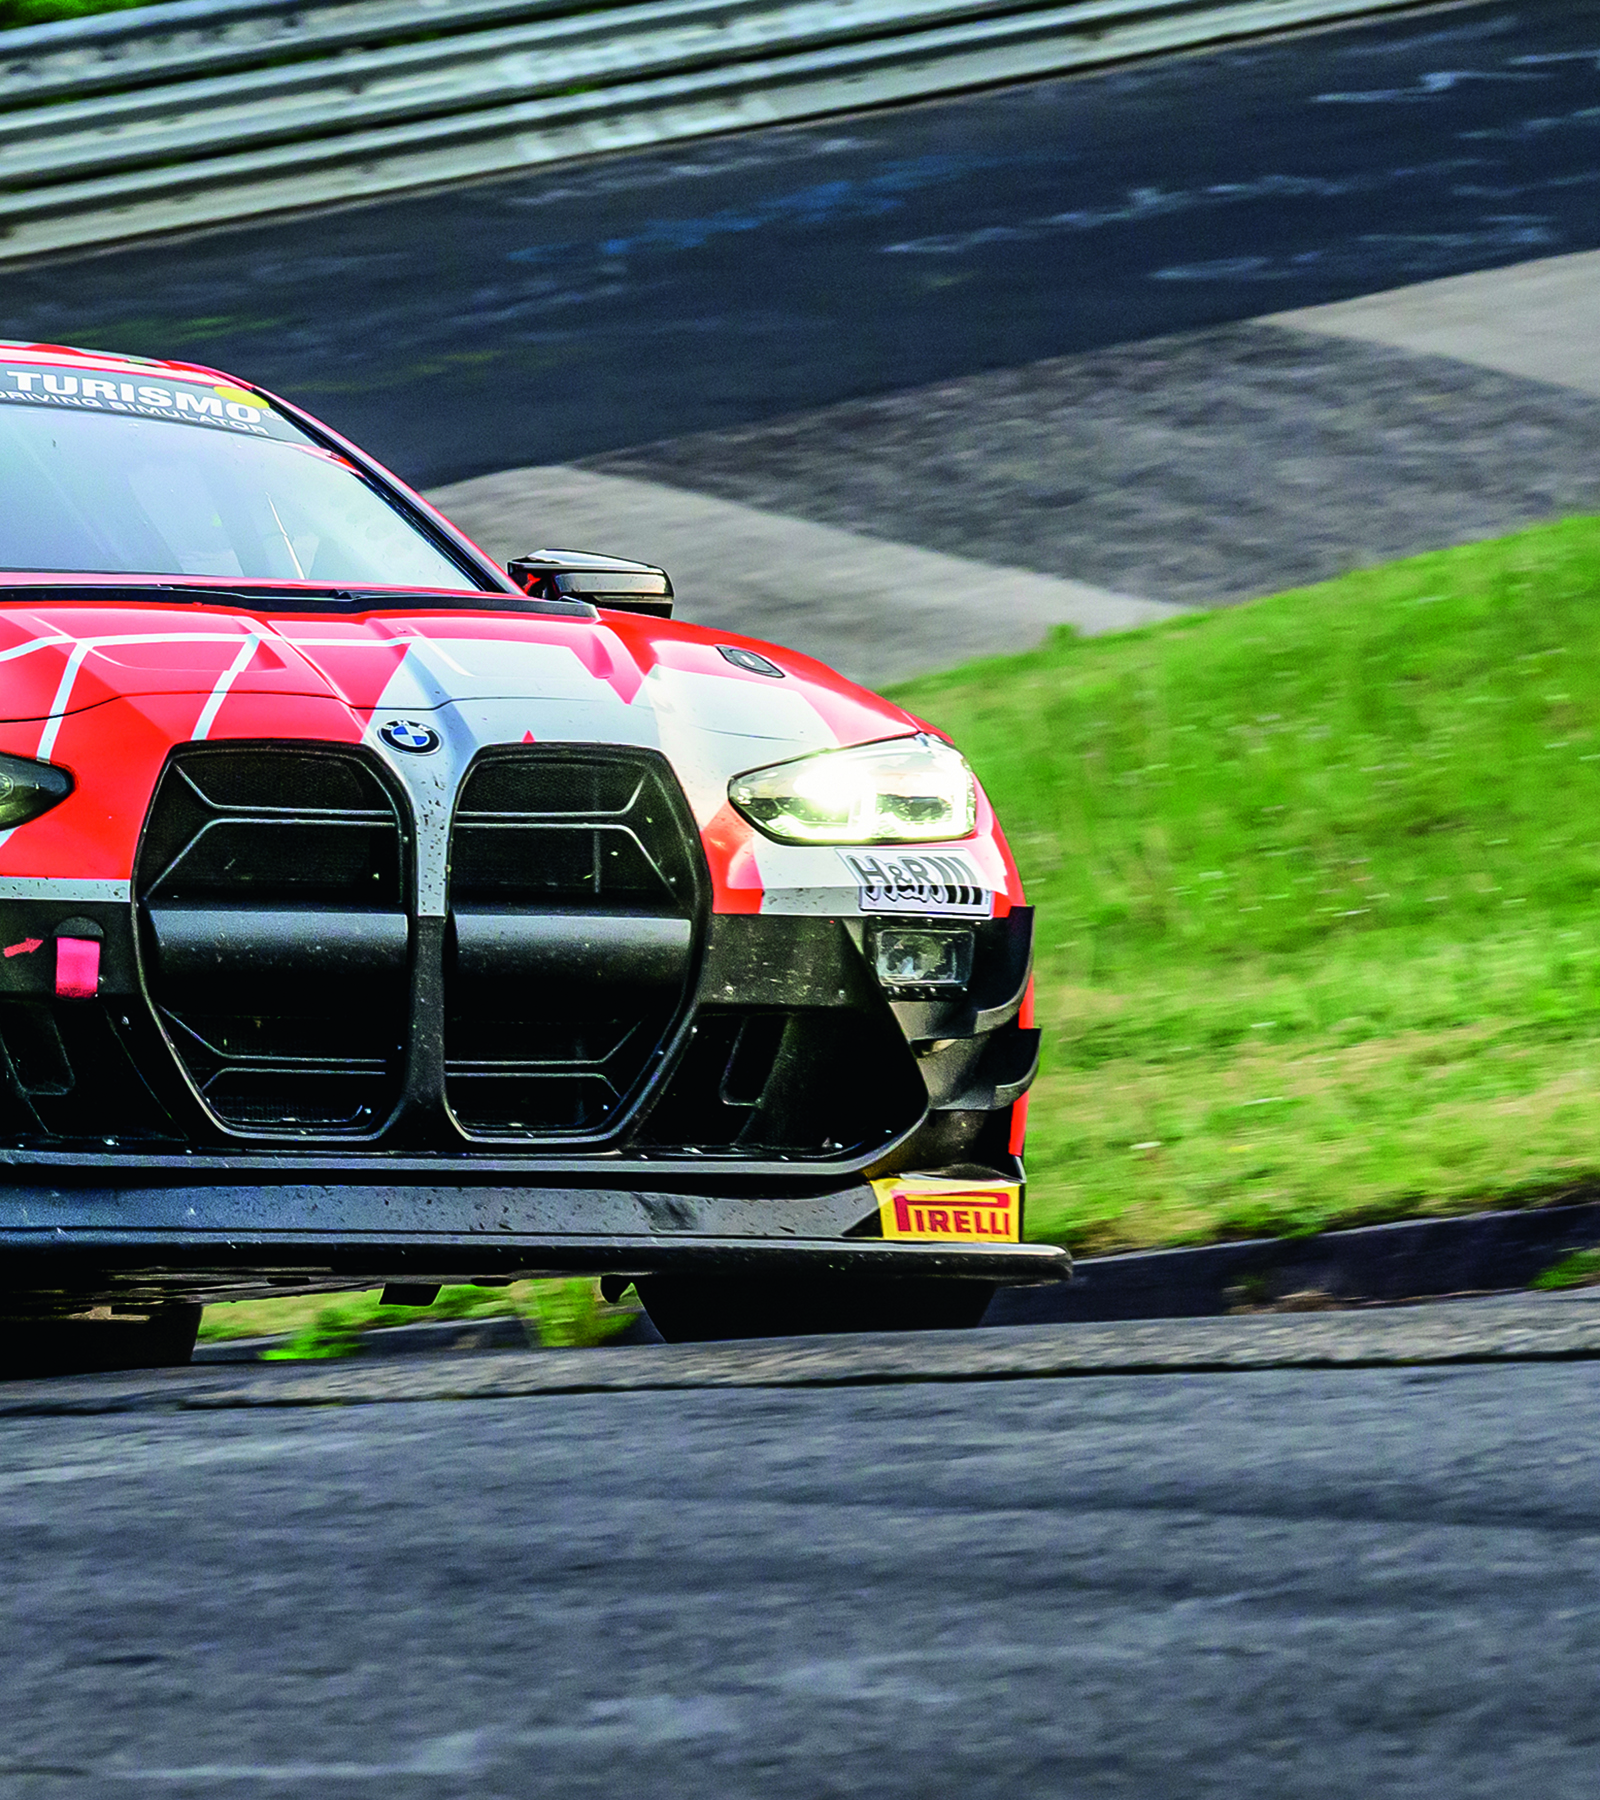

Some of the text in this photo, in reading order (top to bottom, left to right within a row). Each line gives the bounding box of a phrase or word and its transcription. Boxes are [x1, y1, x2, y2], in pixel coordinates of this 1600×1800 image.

[6, 370, 261, 424] TURISMO
[109, 401, 269, 435] SIMULATOR
[847, 855, 941, 901] H&R
[891, 1190, 1011, 1237] PIRELLI
